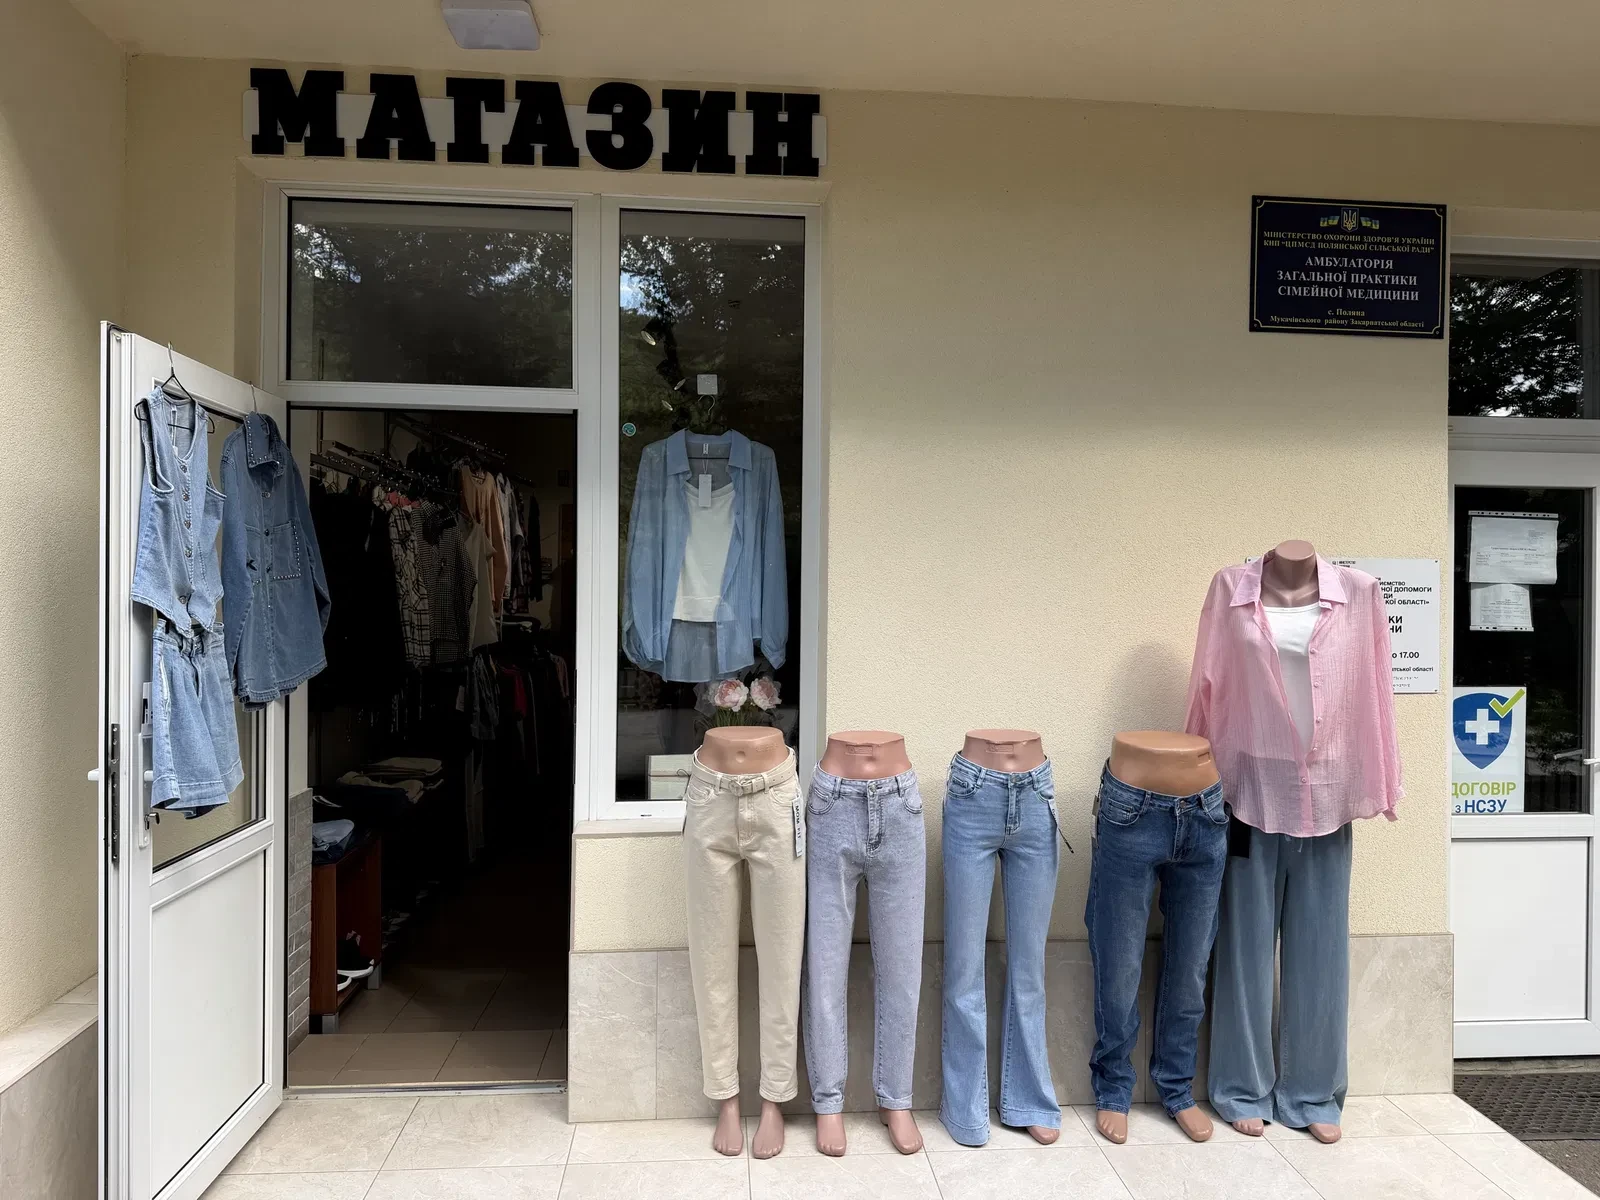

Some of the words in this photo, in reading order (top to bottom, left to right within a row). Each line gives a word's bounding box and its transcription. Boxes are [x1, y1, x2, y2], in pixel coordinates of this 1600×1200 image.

[250, 67, 820, 177] МАГАЗИН
[1263, 230, 1322, 240] МІНІСТЕРСТВО
[1323, 233, 1361, 242] ОХОРОНИ
[1401, 237, 1435, 245] УКРАЇНИ
[1263, 239, 1280, 247] КНП
[1318, 242, 1368, 251] ПОЛЯНСЬКОЇ
[1369, 243, 1410, 253] СІЛЬСЬКОЇ
[1305, 256, 1394, 270] АМБУЛАТОРІЯ
[1277, 270, 1347, 283] ЗАГАЛЬНОЇ
[1351, 274, 1417, 286] ПРАКТИКИ
[1278, 285, 1343, 298] СІМЕЙНОЇ
[1347, 288, 1419, 301] МЕДИЦИНИ
[1336, 308, 1365, 317] Поляна
[1270, 315, 1321, 325] Мукачівського
[1324, 318, 1348, 327] району
[1350, 319, 1399, 329] Закарпатської
[1400, 320, 1425, 328] області
[1388, 615, 1403, 624] КИ
[1451, 782, 1517, 798] ДОГОВІР
[1464, 799, 1507, 813] НСЗУ
